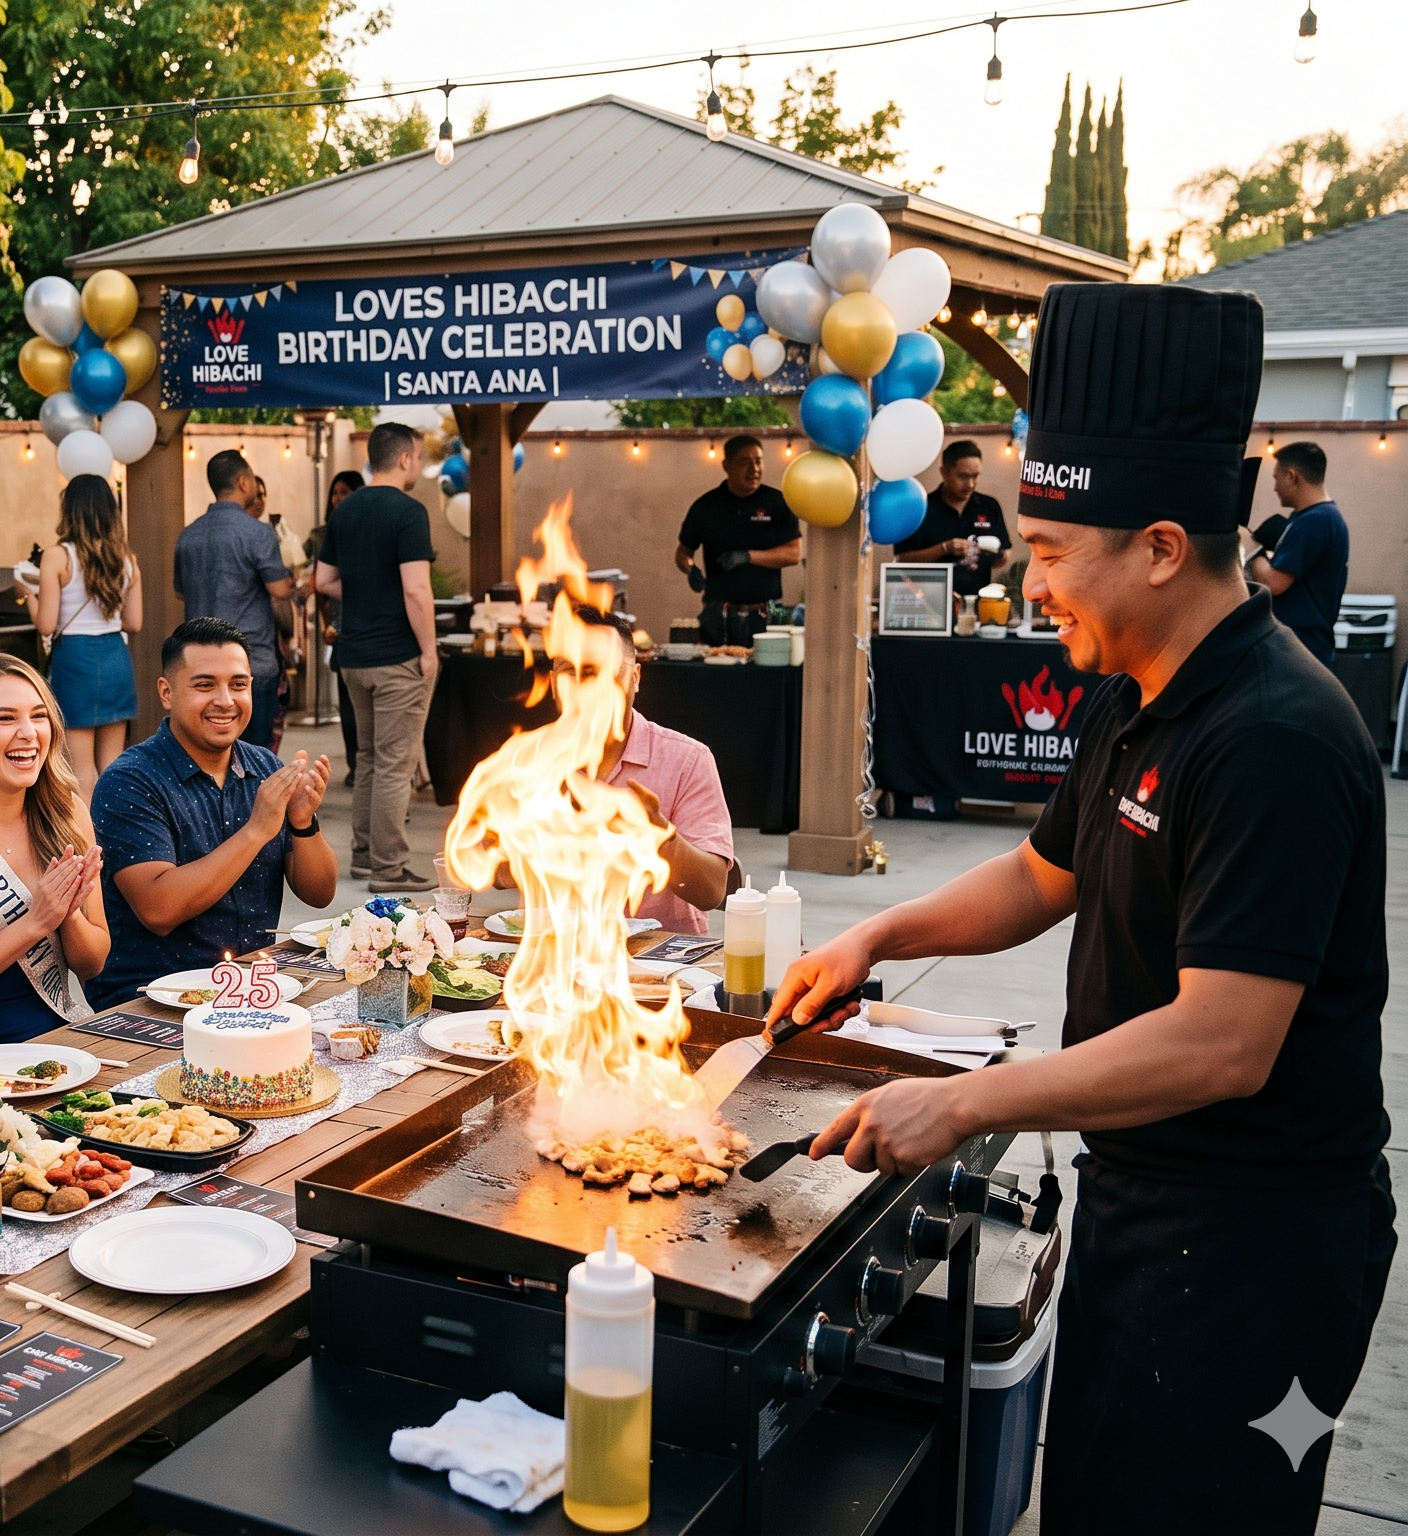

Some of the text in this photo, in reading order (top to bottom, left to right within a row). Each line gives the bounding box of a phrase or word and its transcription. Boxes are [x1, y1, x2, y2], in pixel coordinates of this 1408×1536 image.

[335, 276, 607, 322] LOVES HIBACHI
[204, 344, 249, 363] LOVE
[277, 314, 683, 365] BIRTHDAY CELEBRATION
[192, 363, 262, 383] HIBACHI
[397, 370, 483, 396] SANTA
[487, 367, 547, 394] ANA
[1023, 459, 1091, 491] HIBACHI
[964, 730, 1079, 760] LOVE HIBA
[211, 963, 280, 1010] 25
